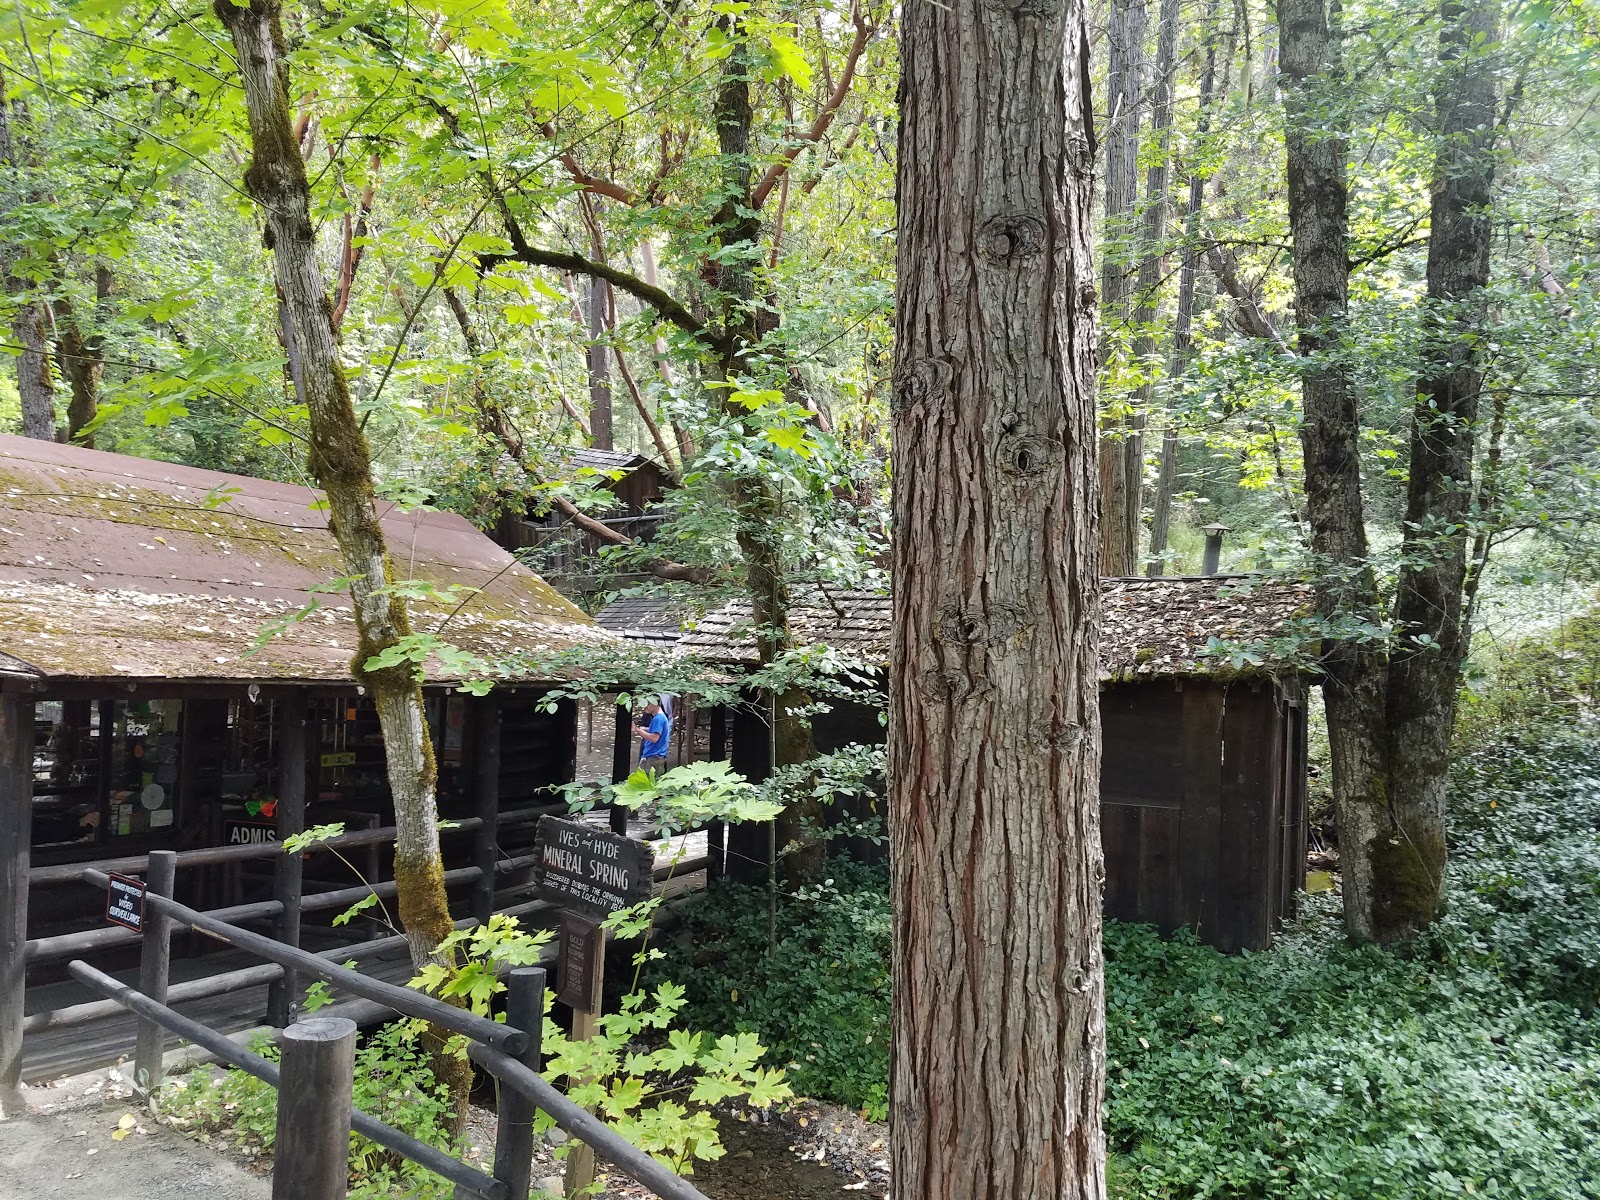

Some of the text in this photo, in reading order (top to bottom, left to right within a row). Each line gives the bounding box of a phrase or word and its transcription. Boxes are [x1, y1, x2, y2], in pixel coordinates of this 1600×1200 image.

[558, 829, 620, 860] IVES and HYDE
[543, 843, 629, 891] MINERAL SPRING
[545, 870, 625, 905] DISCOVERED DURING THE ORIGINAL
[560, 884, 568, 892] OF
[569, 887, 580, 897] THIS
[581, 891, 608, 907] LOCALITY
[109, 905, 141, 926] SURVEILLANCE
[118, 898, 134, 911] VIDEO
[569, 934, 584, 947] GOLD
